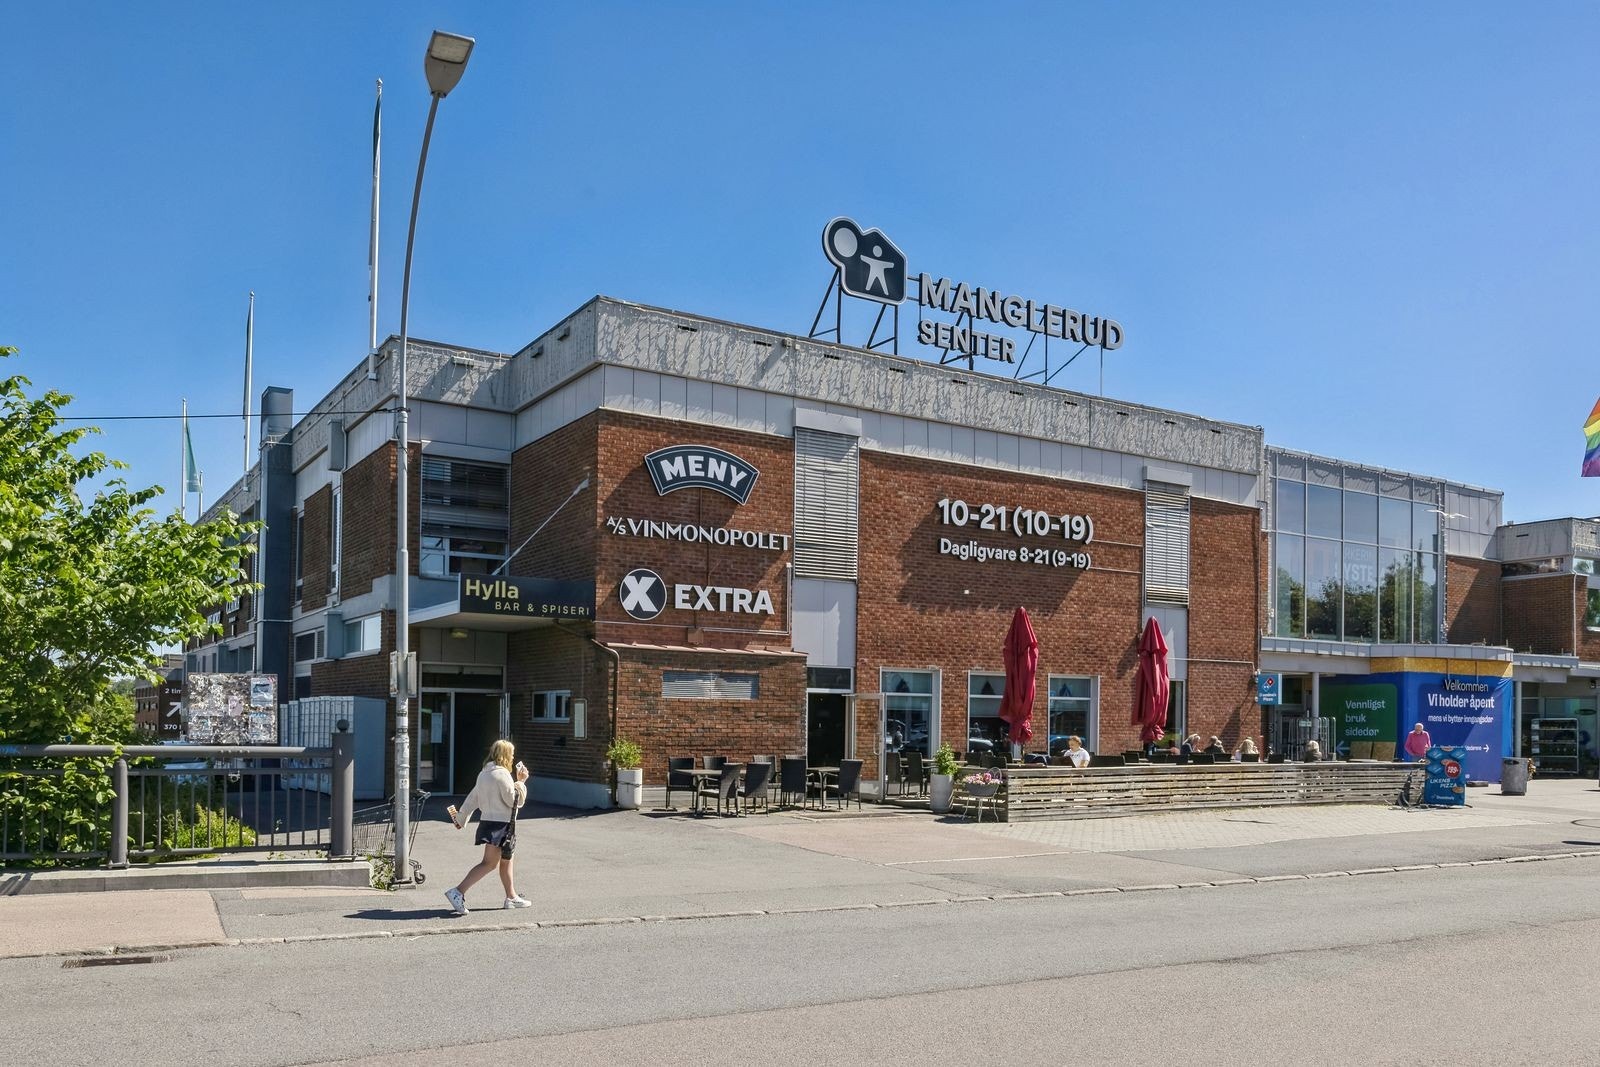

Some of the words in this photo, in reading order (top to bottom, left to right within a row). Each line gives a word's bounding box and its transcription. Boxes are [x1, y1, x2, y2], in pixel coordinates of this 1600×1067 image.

[919, 272, 1125, 351] MANGLERUD
[918, 319, 1017, 364] SENTER
[660, 455, 748, 488] MENY
[626, 517, 792, 551] VINMONOPOLET
[937, 498, 1006, 532] 10-21
[1013, 505, 1094, 545] (10-19)
[940, 538, 1017, 563] Dagligvare
[1019, 547, 1049, 565] 8-21
[1052, 549, 1092, 571] (9-19)
[465, 578, 519, 601] Hylla
[621, 575, 658, 612] X
[674, 583, 775, 615] EXTRA
[495, 601, 520, 612] BAR
[527, 604, 534, 612] &
[542, 604, 590, 616] SPISERI
[1444, 679, 1489, 692] Velkommen
[1345, 699, 1386, 711] Vennligst
[1428, 693, 1439, 707] Vi
[1439, 694, 1469, 708] holder
[1470, 695, 1495, 711] åpent
[1345, 713, 1366, 722] bruk
[1345, 727, 1379, 737] sidedør
